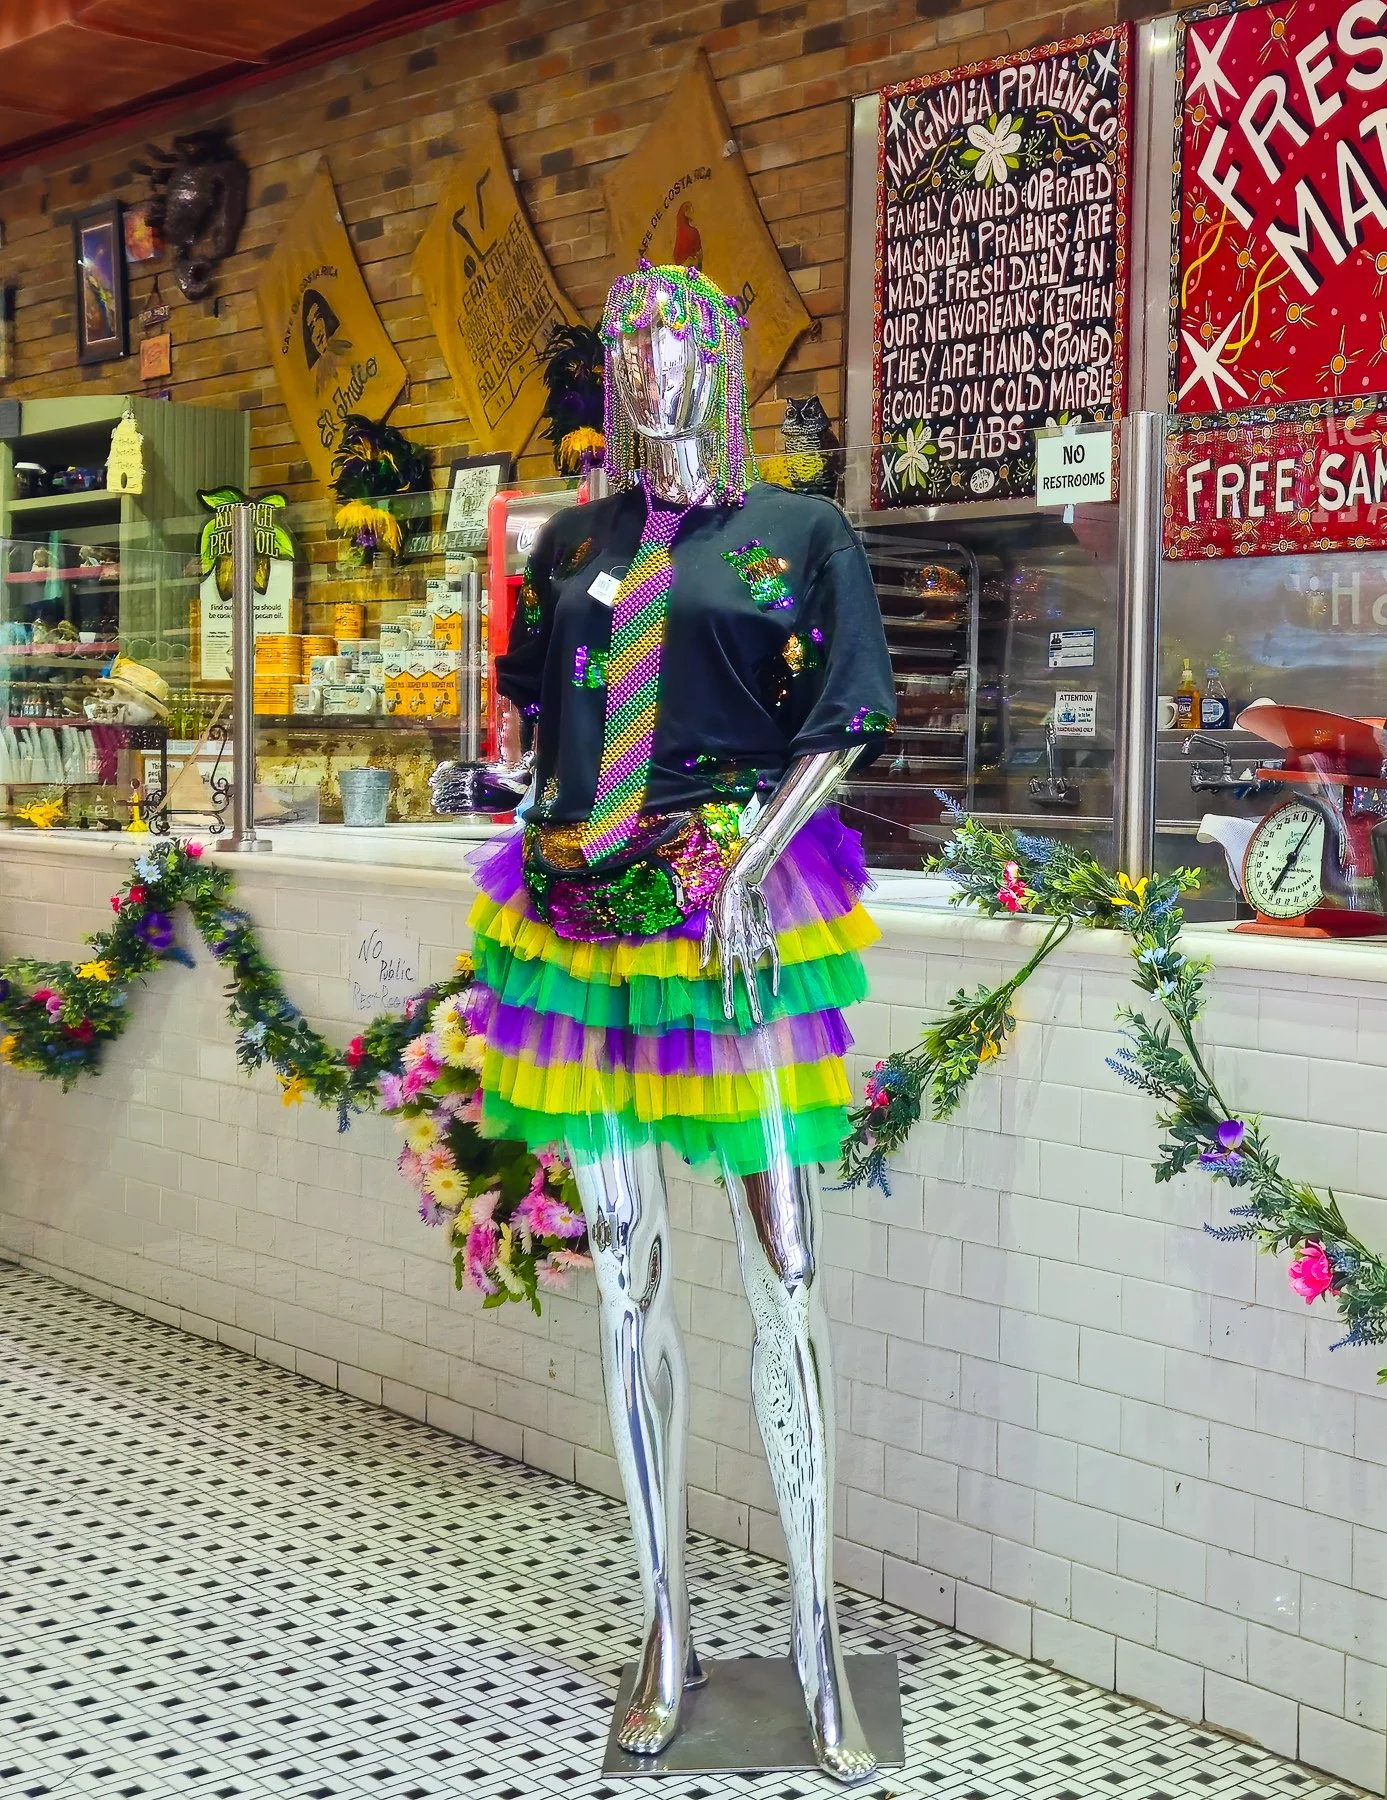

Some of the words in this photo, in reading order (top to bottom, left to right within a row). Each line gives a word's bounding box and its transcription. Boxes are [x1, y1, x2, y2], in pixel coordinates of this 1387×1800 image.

[651, 209, 663, 229] DE
[664, 174, 693, 209] COSTA
[887, 192, 946, 238] FAMILY
[951, 183, 1017, 226] OWNED
[978, 212, 1069, 260] PRALINES
[1073, 203, 1113, 241] ARE
[888, 272, 938, 312] MADE
[945, 258, 1006, 302] FRESH
[1009, 244, 1070, 292] DAILY
[1073, 241, 1105, 278] IN
[883, 313, 919, 349] OUR
[1043, 282, 1113, 326] KITCHEN
[882, 345, 936, 387] THEY
[939, 342, 978, 382] ARE
[982, 331, 1036, 376] HAND
[1037, 322, 1113, 371] SPOONED
[891, 379, 955, 425] COOLED
[960, 380, 985, 416] ON
[990, 373, 1045, 415] COLD
[1048, 366, 1113, 412] MARBLE
[938, 413, 1026, 462] SLABS
[1062, 444, 1086, 465] NO
[1042, 471, 1106, 491] RESTROOMS
[1186, 458, 1297, 523] FREE
[256, 529, 279, 557] OIL
[261, 603, 281, 611] should
[1060, 694, 1093, 702] ATTENTION
[1301, 811, 1308, 823] 0
